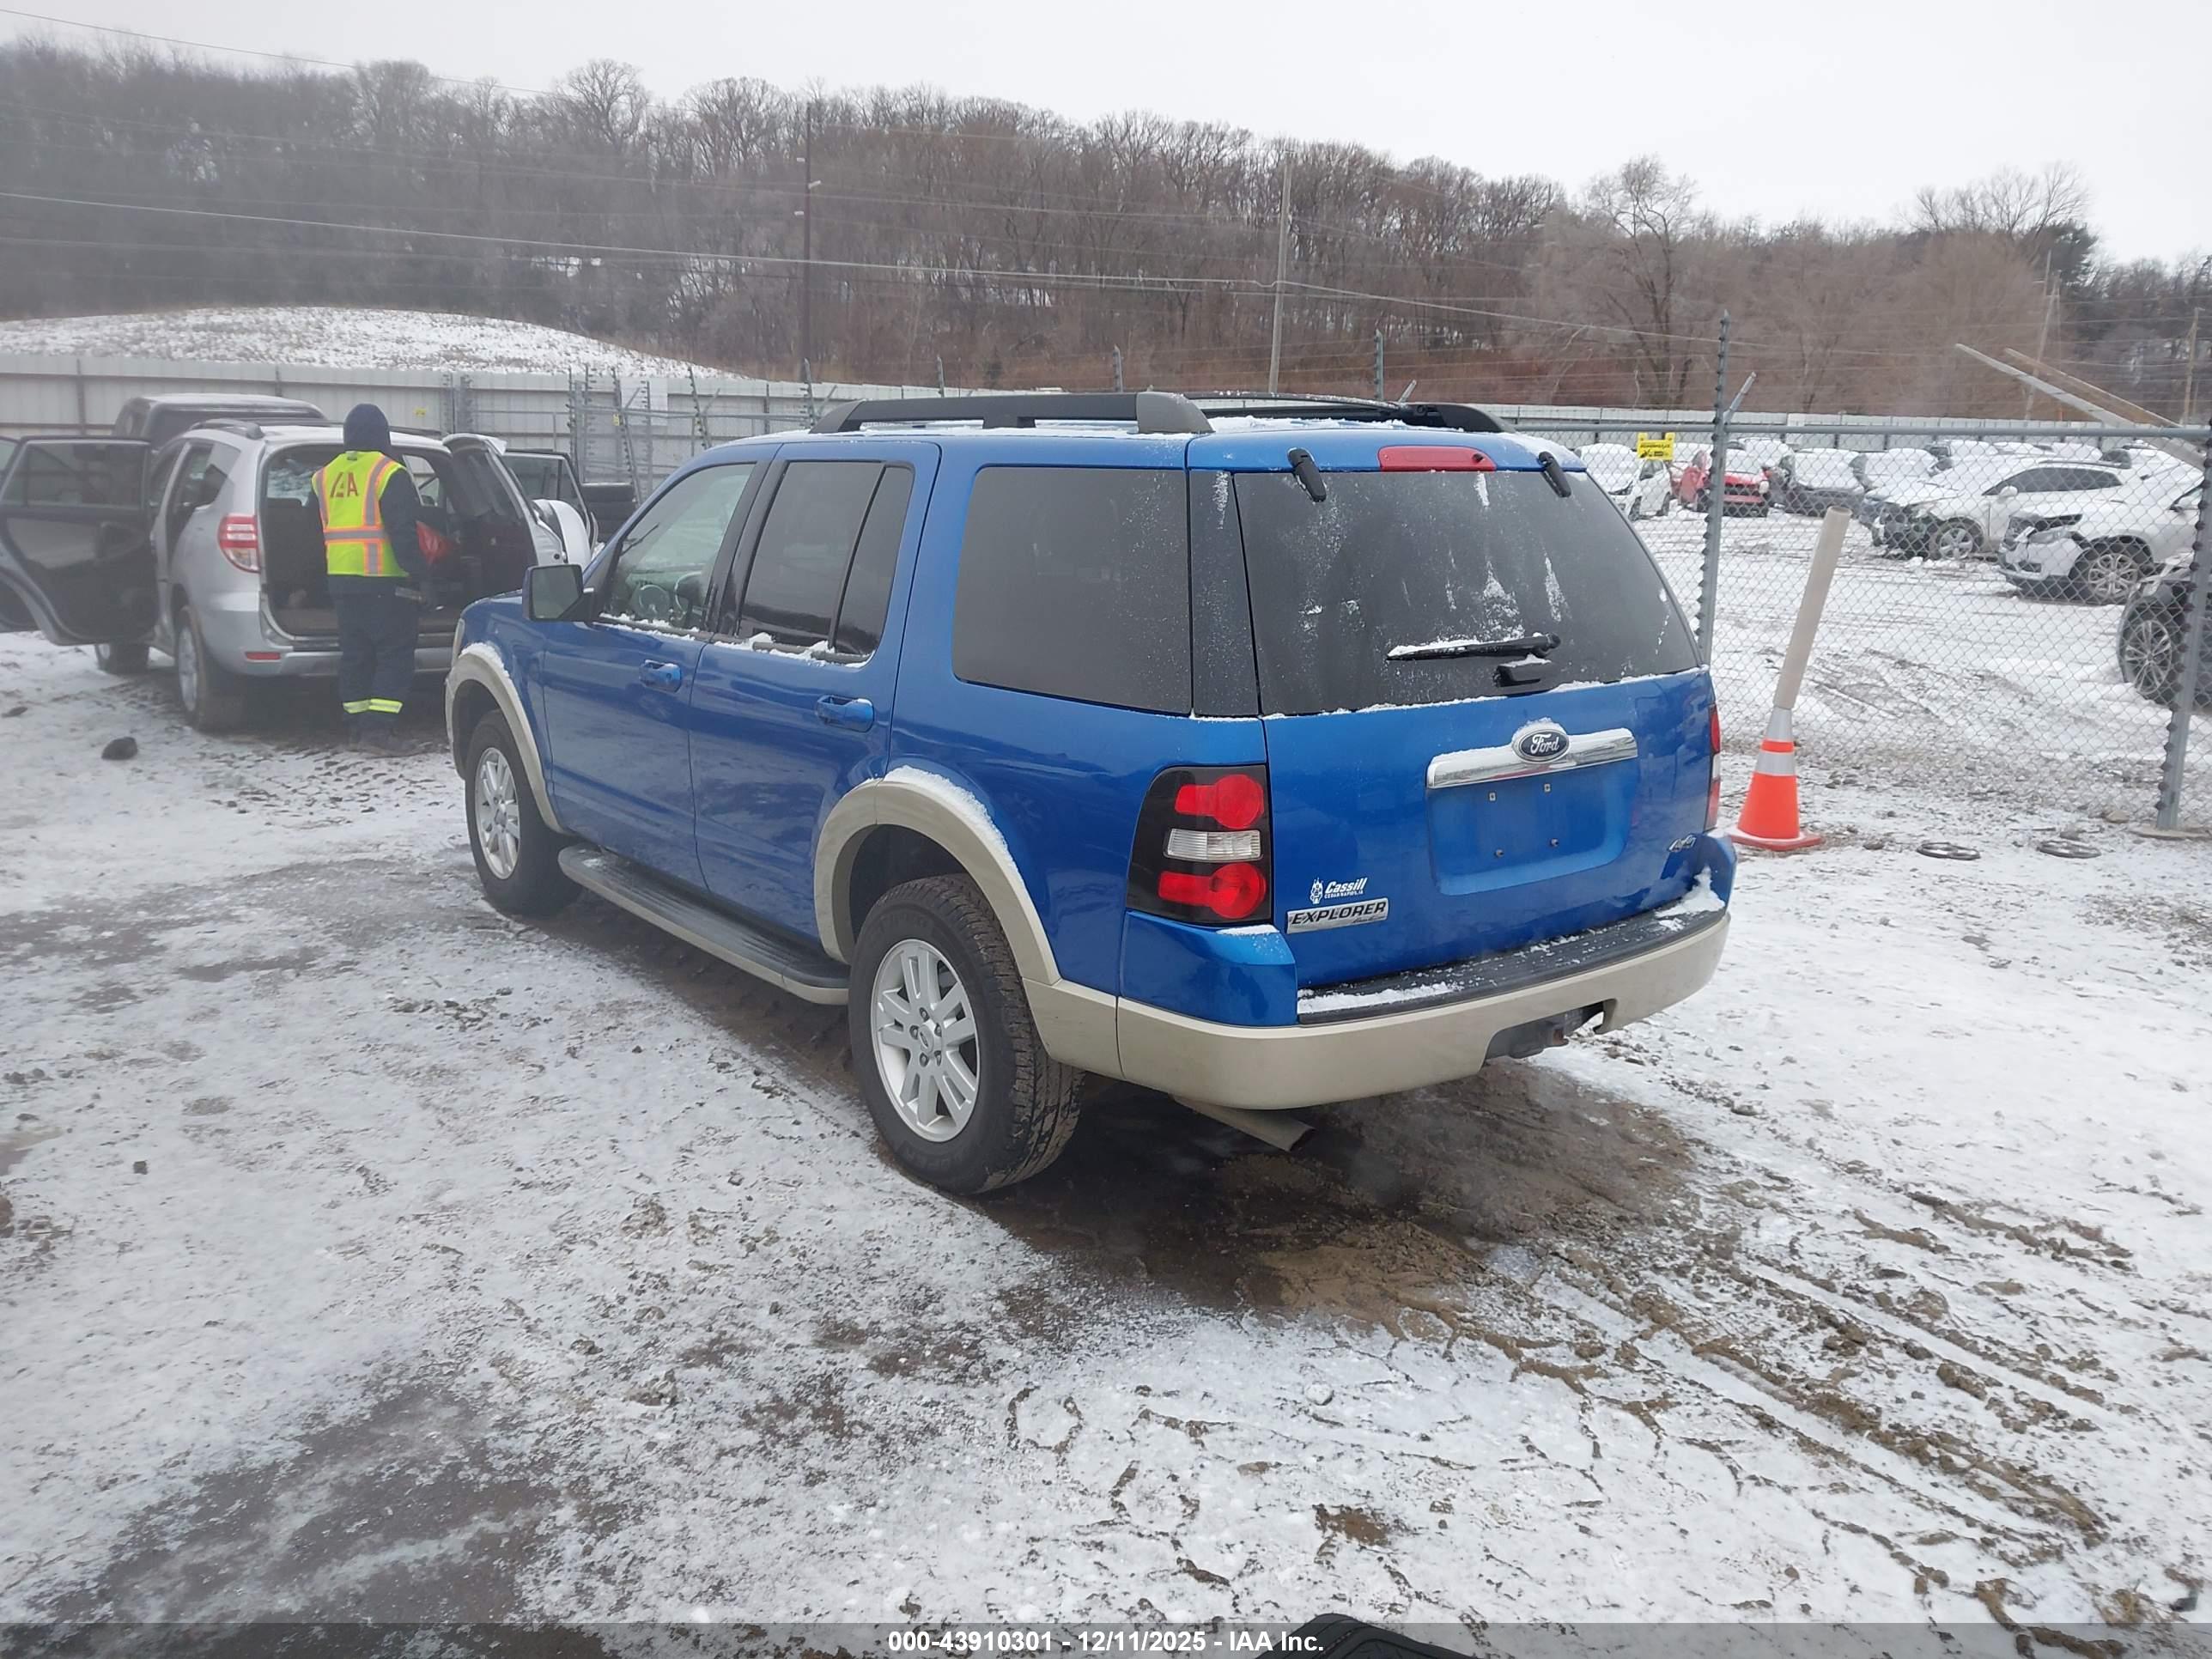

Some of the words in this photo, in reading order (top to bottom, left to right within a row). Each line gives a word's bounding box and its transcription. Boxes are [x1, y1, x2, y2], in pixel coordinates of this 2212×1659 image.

[1530, 733, 1560, 754] Ford
[1325, 877, 1368, 894] Cassill
[1291, 901, 1387, 925] EXPLORER
